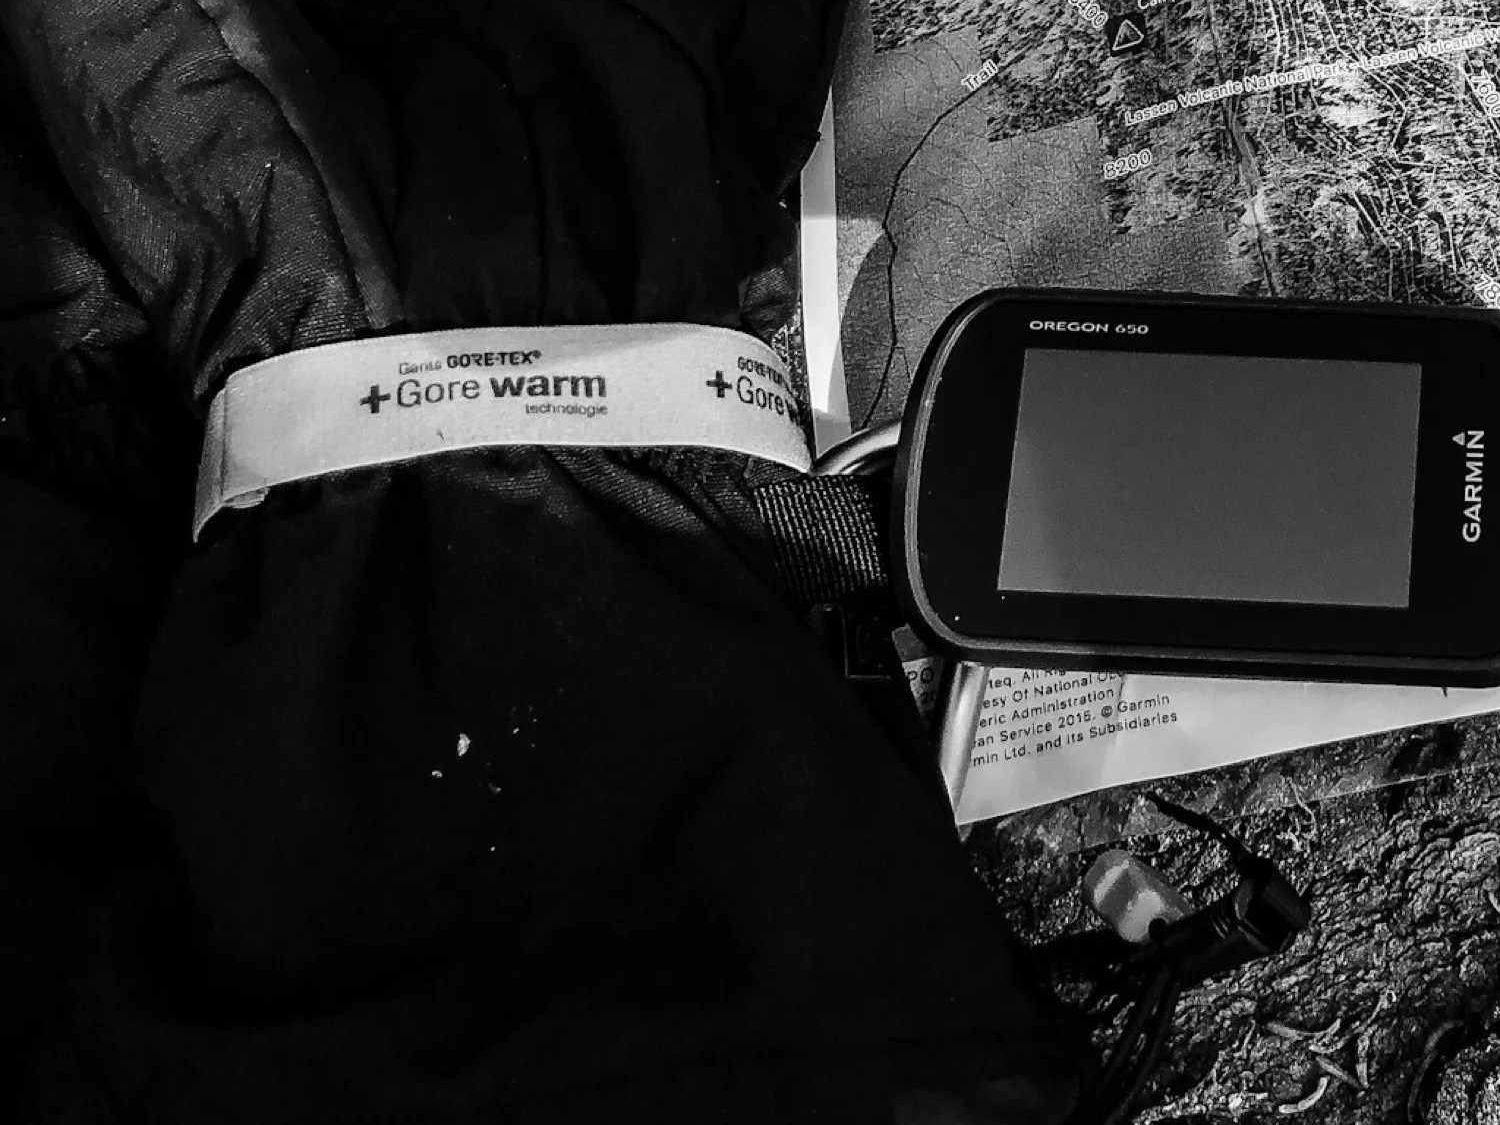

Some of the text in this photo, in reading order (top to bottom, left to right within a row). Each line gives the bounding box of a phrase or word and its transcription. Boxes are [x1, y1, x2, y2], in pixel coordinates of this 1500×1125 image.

[962, 59, 998, 90] Trail
[1125, 99, 1177, 124] Lassen
[1178, 80, 1242, 107] Volcanic
[1244, 65, 1311, 94] National
[1313, 60, 1347, 78] Park
[1361, 48, 1418, 70] Lassen
[1418, 32, 1484, 56] Volcanic
[1104, 150, 1152, 178] 8200
[1029, 320, 1150, 335] OREGON 650
[489, 374, 607, 398] warm
[525, 402, 608, 417] technologie
[1462, 429, 1486, 543] GARMIN
[979, 688, 1114, 728] eric Administration
[982, 695, 1007, 709] esy
[1034, 673, 1092, 696] National
[1000, 722, 1052, 742] Service
[1117, 693, 1170, 714] Garmin
[1004, 744, 1031, 761] Ltd.
[1036, 734, 1061, 753] and
[1089, 711, 1178, 739] Subsidiaries
